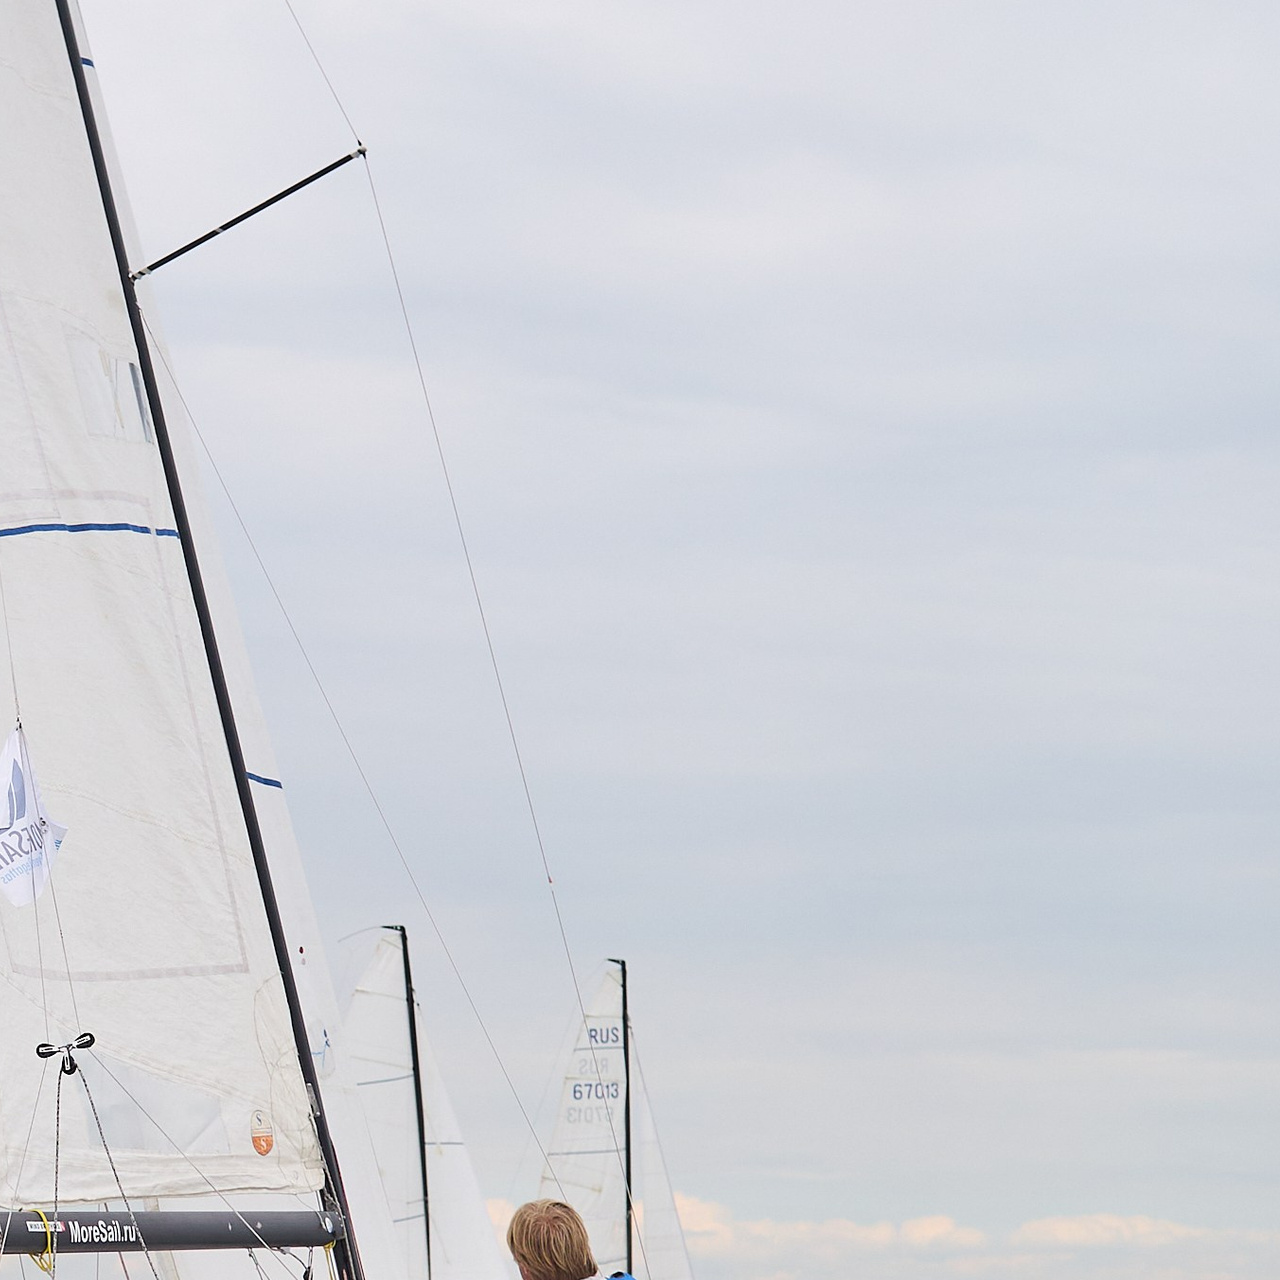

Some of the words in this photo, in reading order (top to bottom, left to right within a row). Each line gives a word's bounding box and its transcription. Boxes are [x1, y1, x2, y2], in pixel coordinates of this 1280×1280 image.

[589, 1027, 619, 1044] RUS
[573, 1082, 619, 1100] 67013
[68, 1220, 136, 1243] MoreSail.ru
